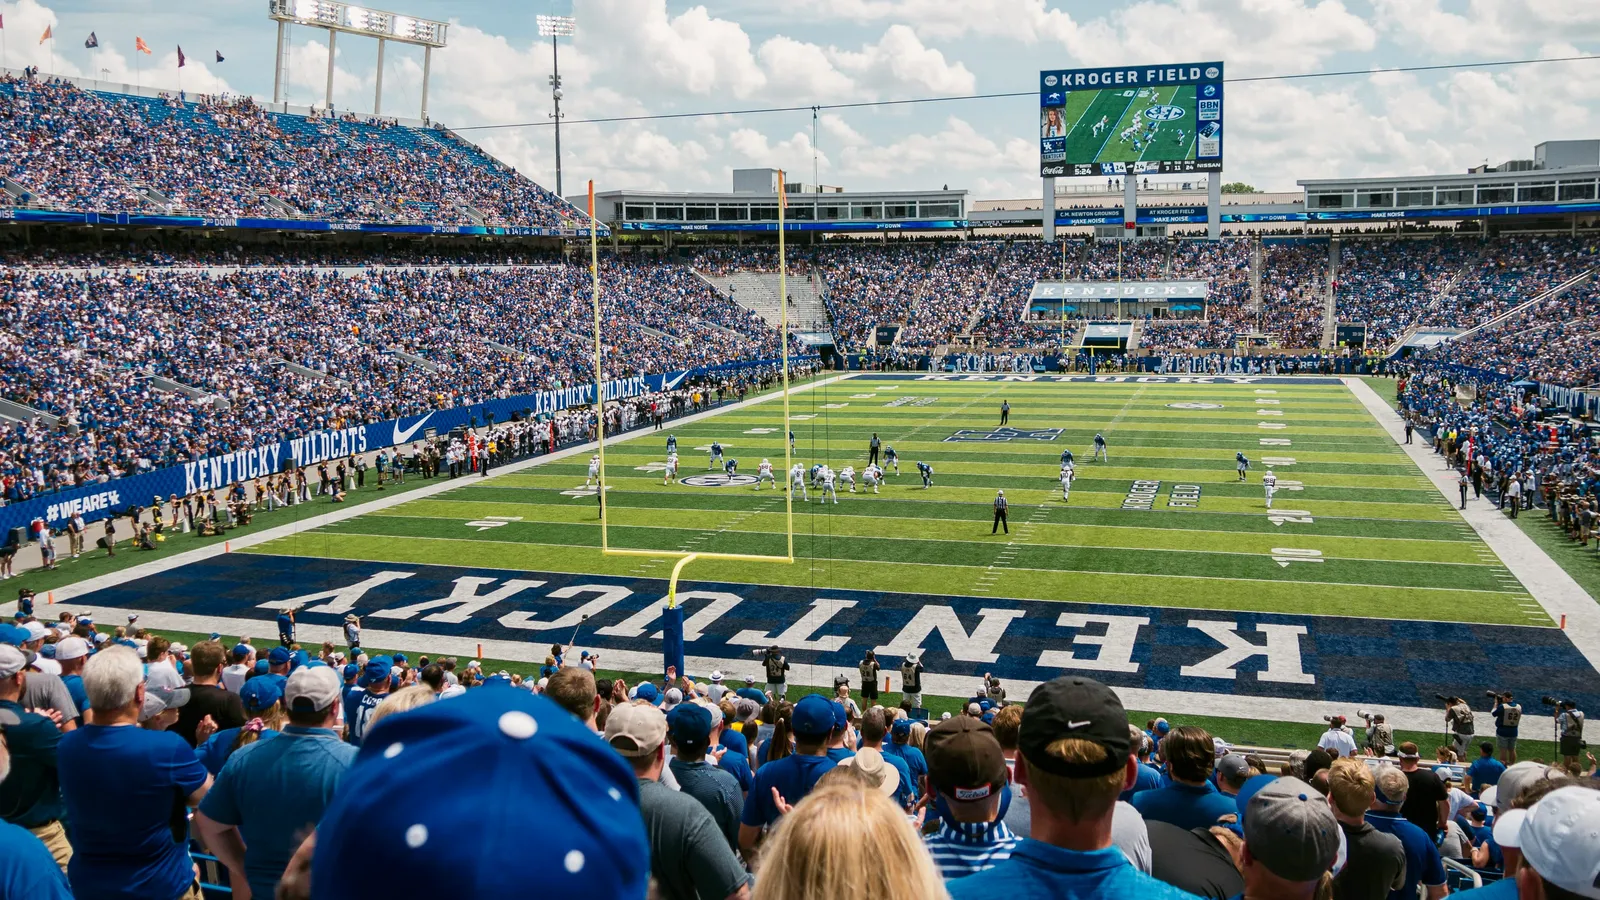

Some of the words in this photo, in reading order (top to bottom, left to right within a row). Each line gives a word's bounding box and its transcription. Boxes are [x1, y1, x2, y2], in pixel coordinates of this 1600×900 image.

[1062, 71, 1138, 86] KROGER
[1147, 67, 1200, 82] FIELD
[1200, 101, 1219, 109] BBN
[215, 218, 237, 226] DOWN
[1042, 286, 1199, 296] KENTUCKY
[535, 384, 592, 414] KENTUCKY
[184, 442, 280, 495] KENTUCKY
[290, 425, 367, 467] WILDCATS
[1168, 485, 1201, 508] FIELD
[255, 571, 1315, 684] KENTUCKY
[1507, 712, 1518, 720] 62
